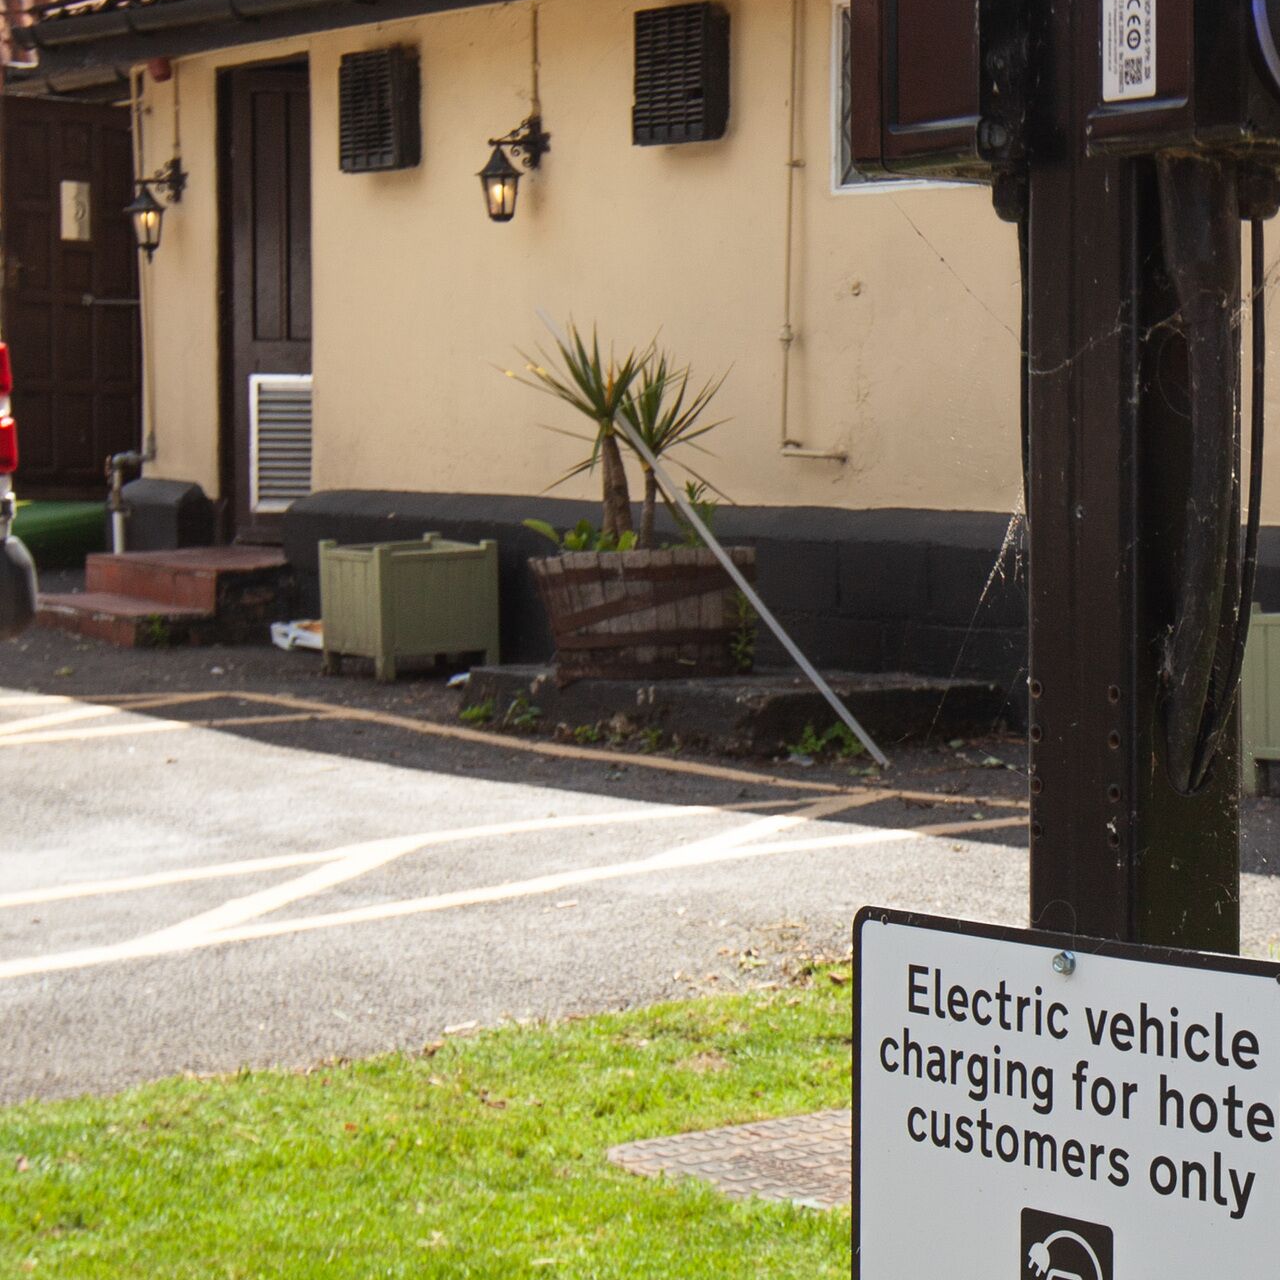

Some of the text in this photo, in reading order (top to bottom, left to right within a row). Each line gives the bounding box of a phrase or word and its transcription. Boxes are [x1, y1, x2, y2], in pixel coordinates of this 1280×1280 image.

[907, 964, 1260, 1070] Electric vehicle
[880, 1028, 1053, 1114] charging
[1072, 1060, 1138, 1119] for
[907, 1105, 1255, 1220] customers only
